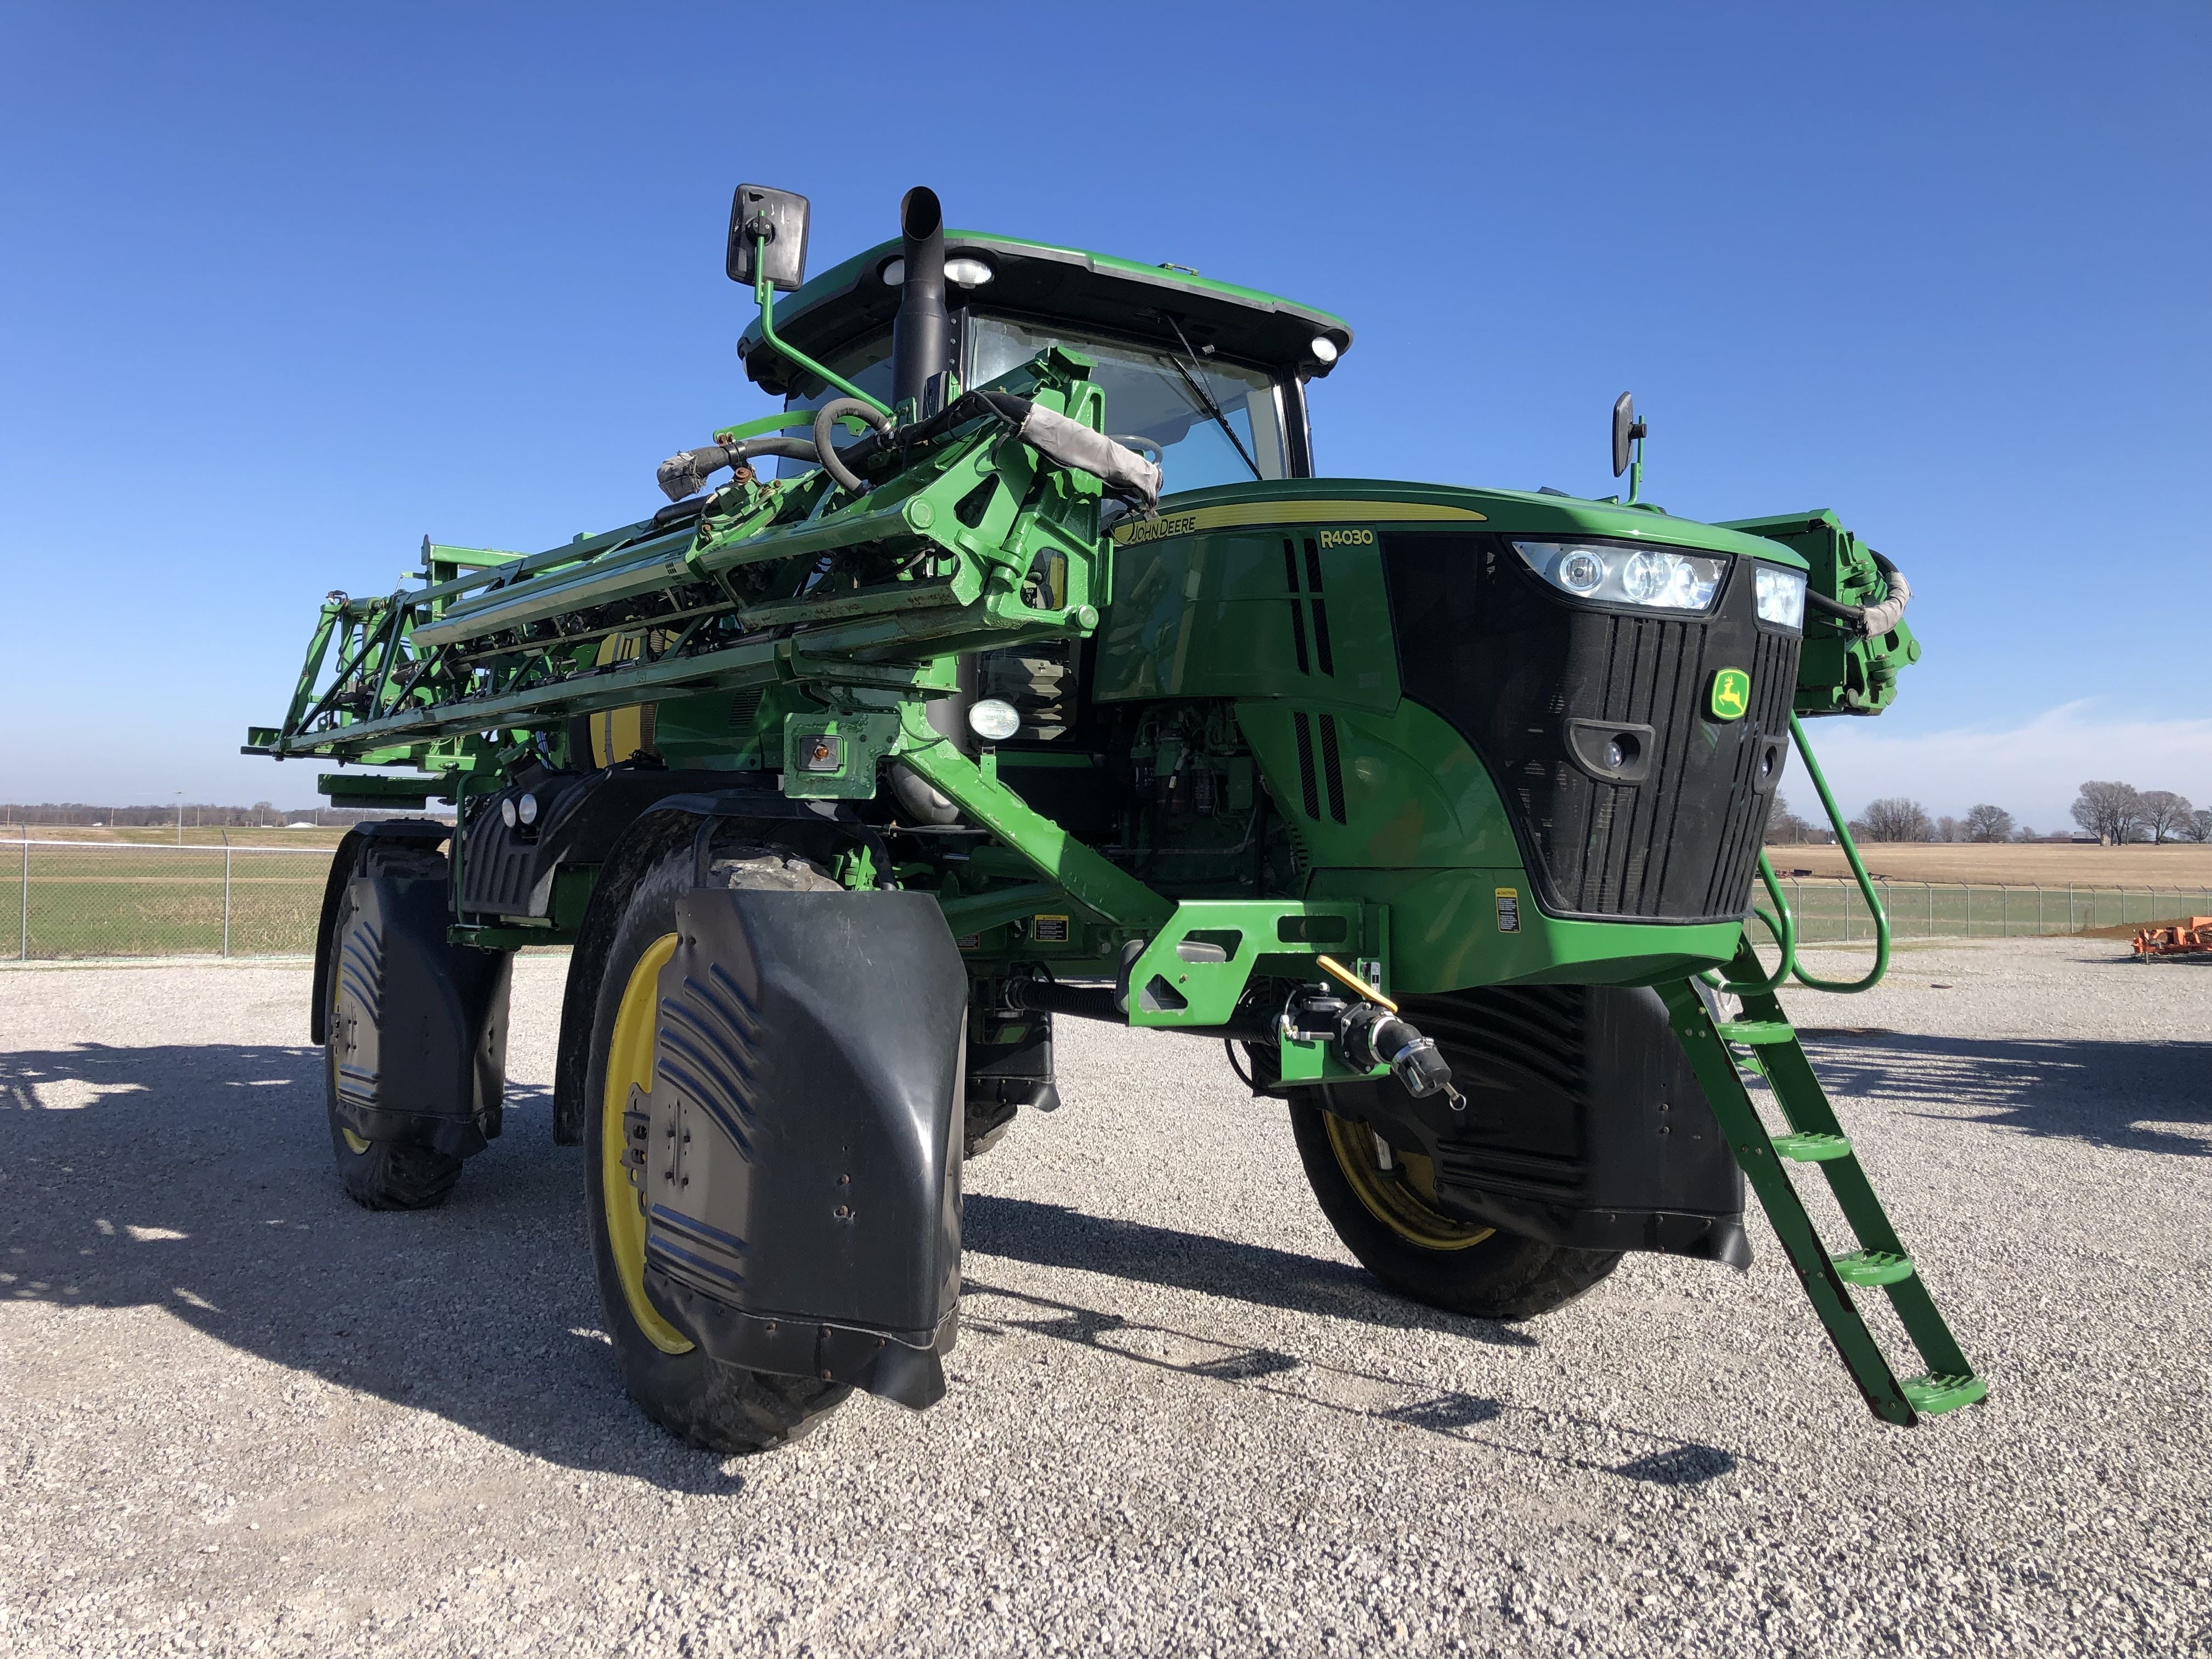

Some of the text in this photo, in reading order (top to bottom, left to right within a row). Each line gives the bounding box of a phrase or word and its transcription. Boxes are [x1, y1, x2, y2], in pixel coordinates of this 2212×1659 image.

[1131, 516, 1196, 542] JOHN DEERE
[1319, 529, 1373, 548] R4030
